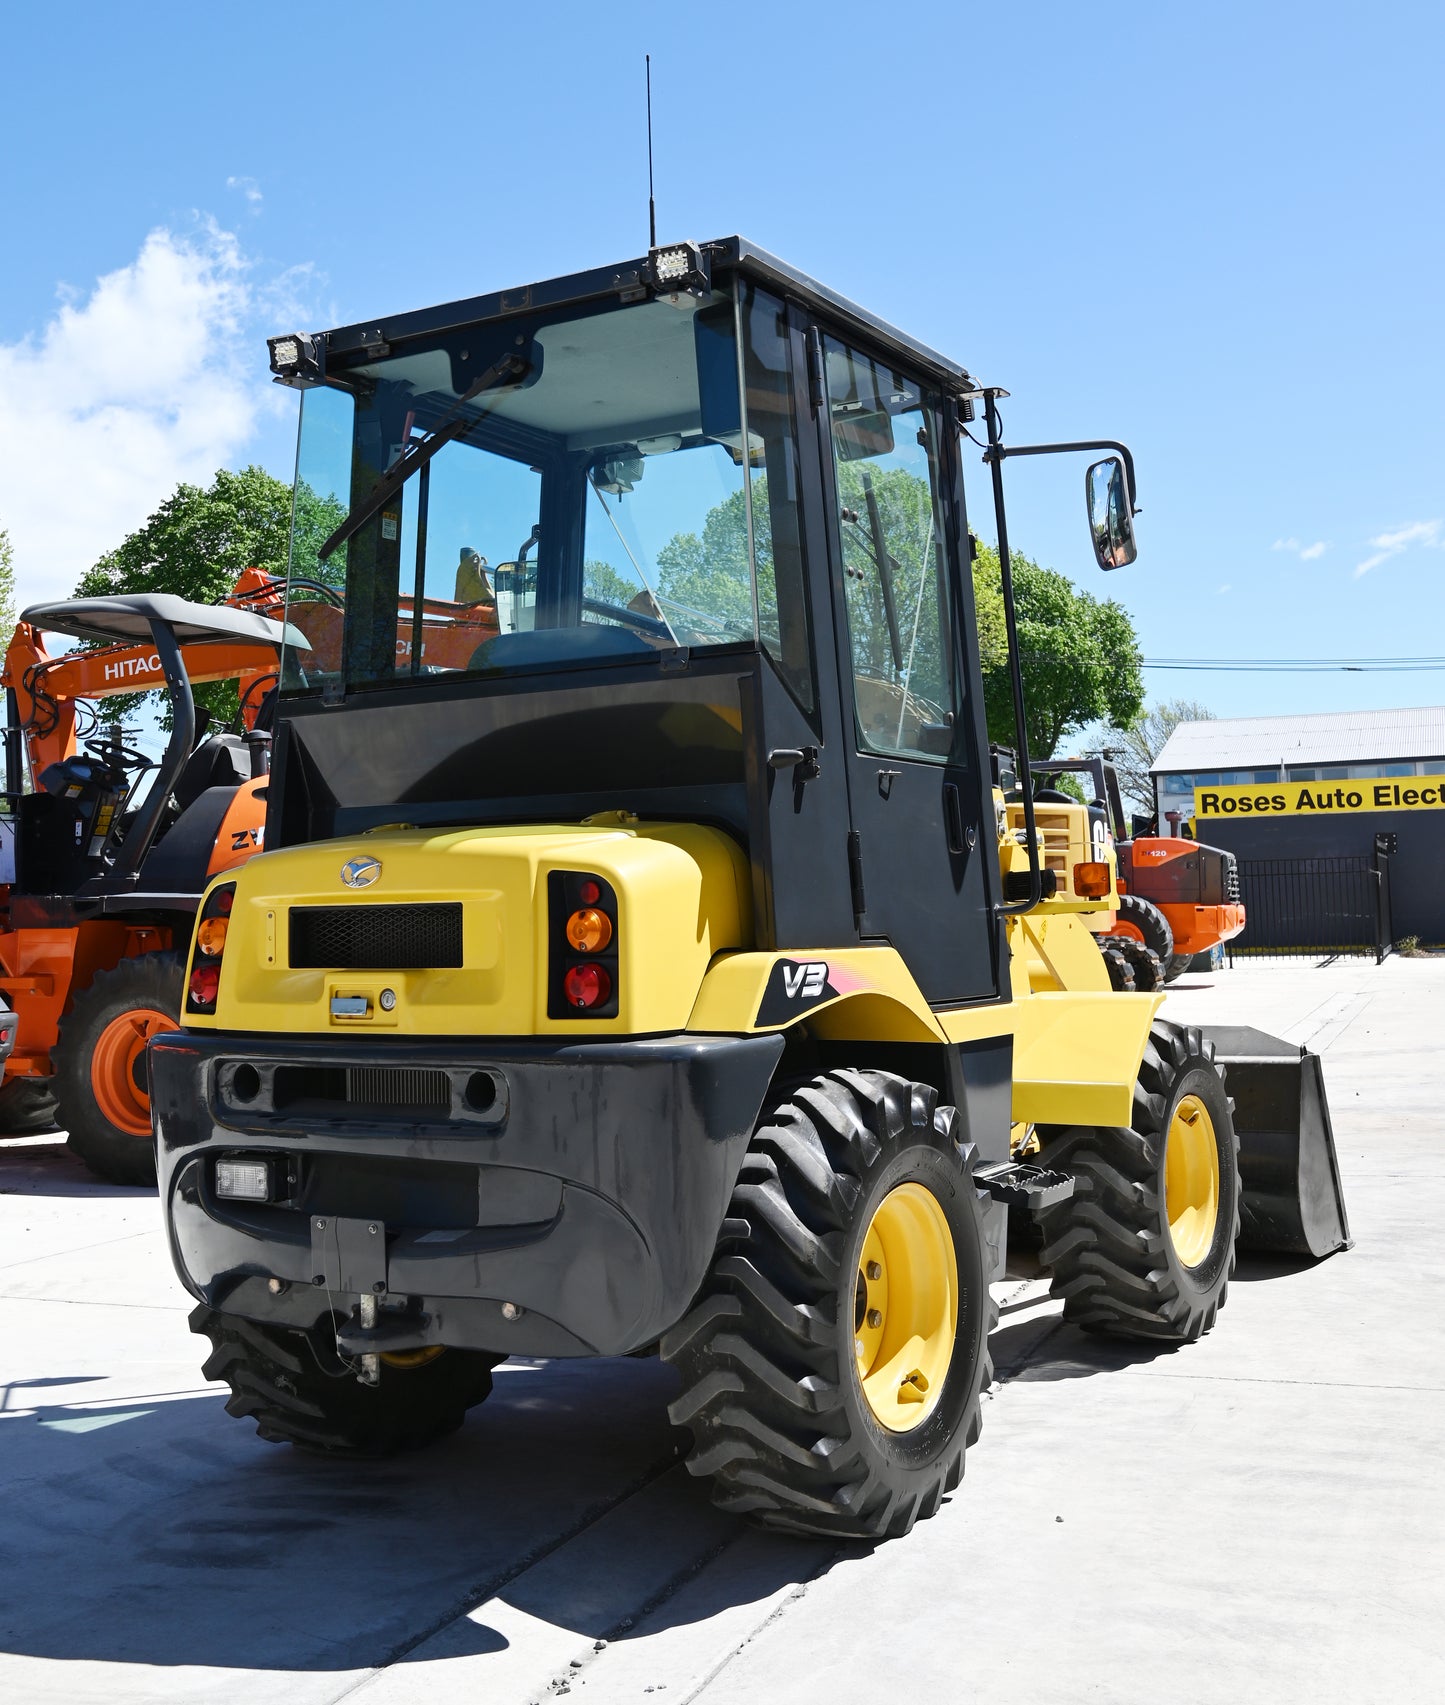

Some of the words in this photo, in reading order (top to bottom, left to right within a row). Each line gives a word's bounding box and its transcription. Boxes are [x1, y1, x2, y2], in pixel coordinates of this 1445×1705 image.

[1201, 793, 1287, 814] Roses
[1295, 788, 1363, 810] Auto
[783, 963, 827, 998] V3
